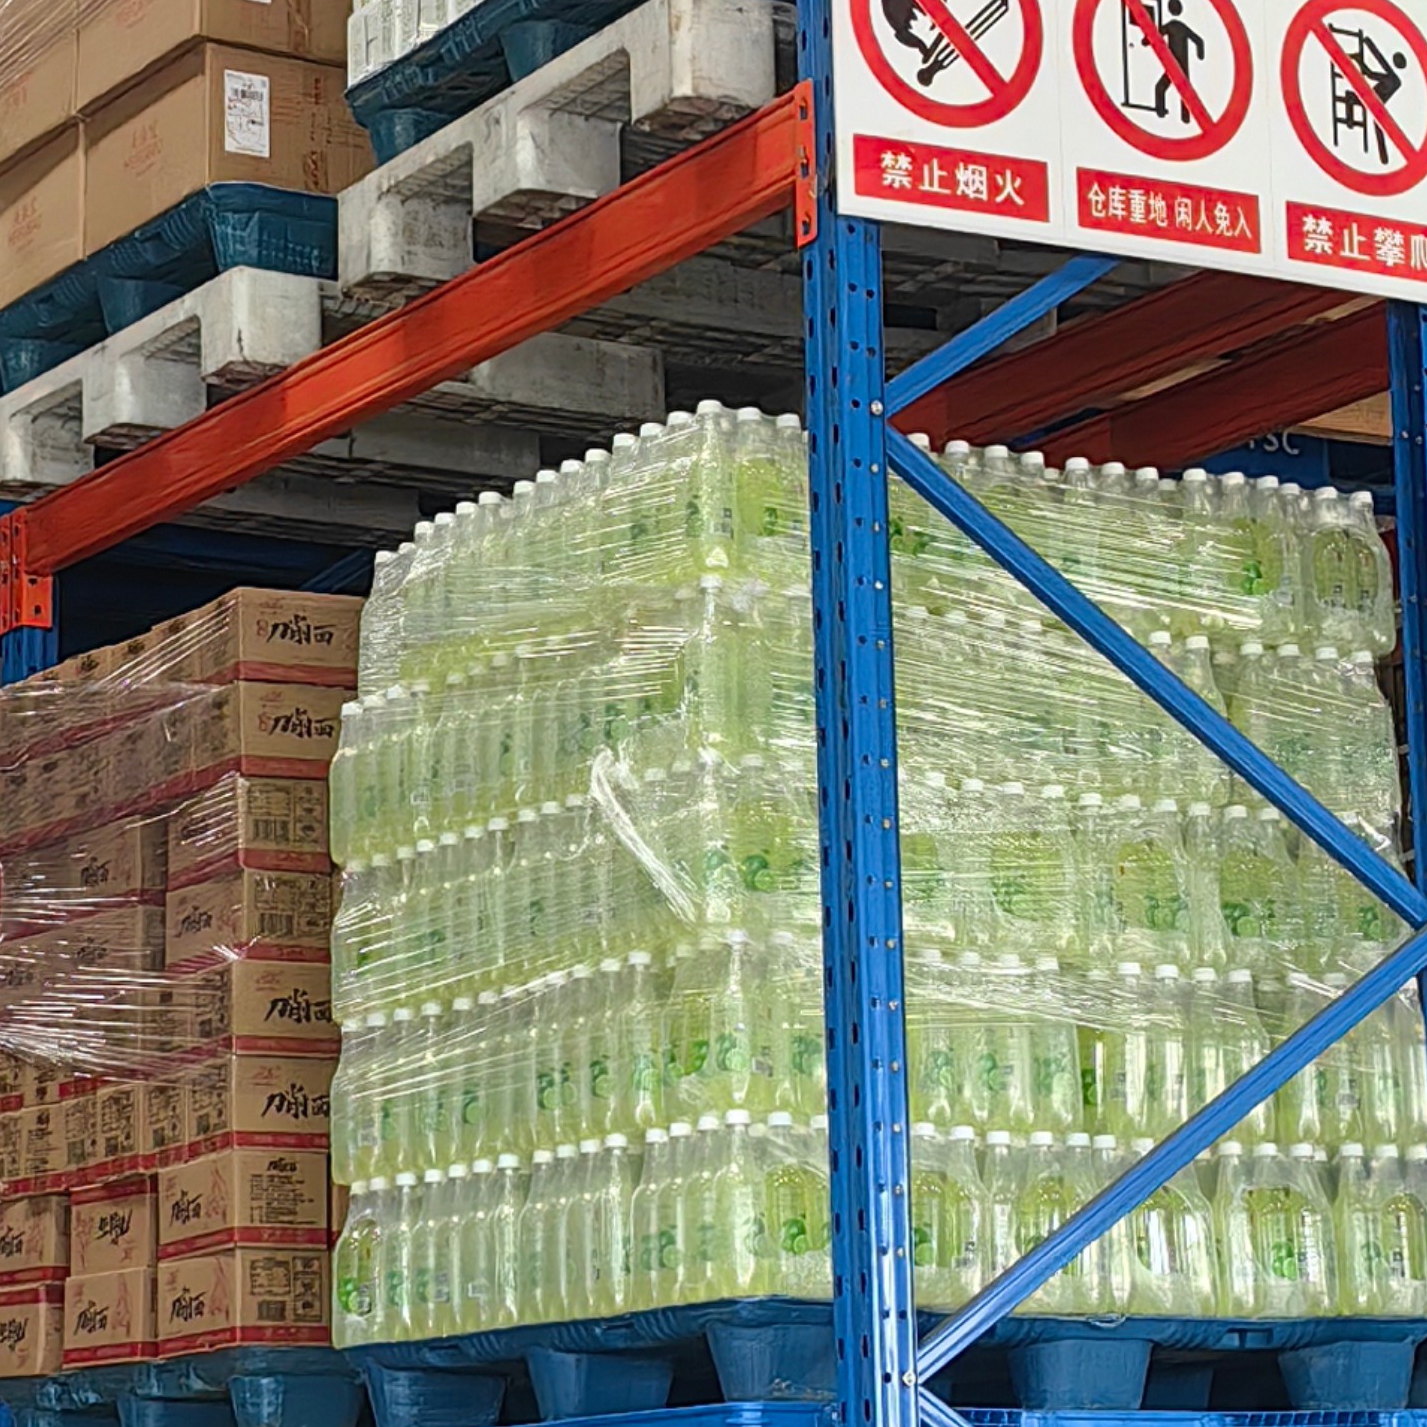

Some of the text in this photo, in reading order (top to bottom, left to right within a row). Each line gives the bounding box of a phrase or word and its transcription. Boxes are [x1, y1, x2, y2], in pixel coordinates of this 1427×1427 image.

[879, 151, 1025, 206] 禁止烟火
[1086, 181, 1253, 240] 仓库重地 闲人免入
